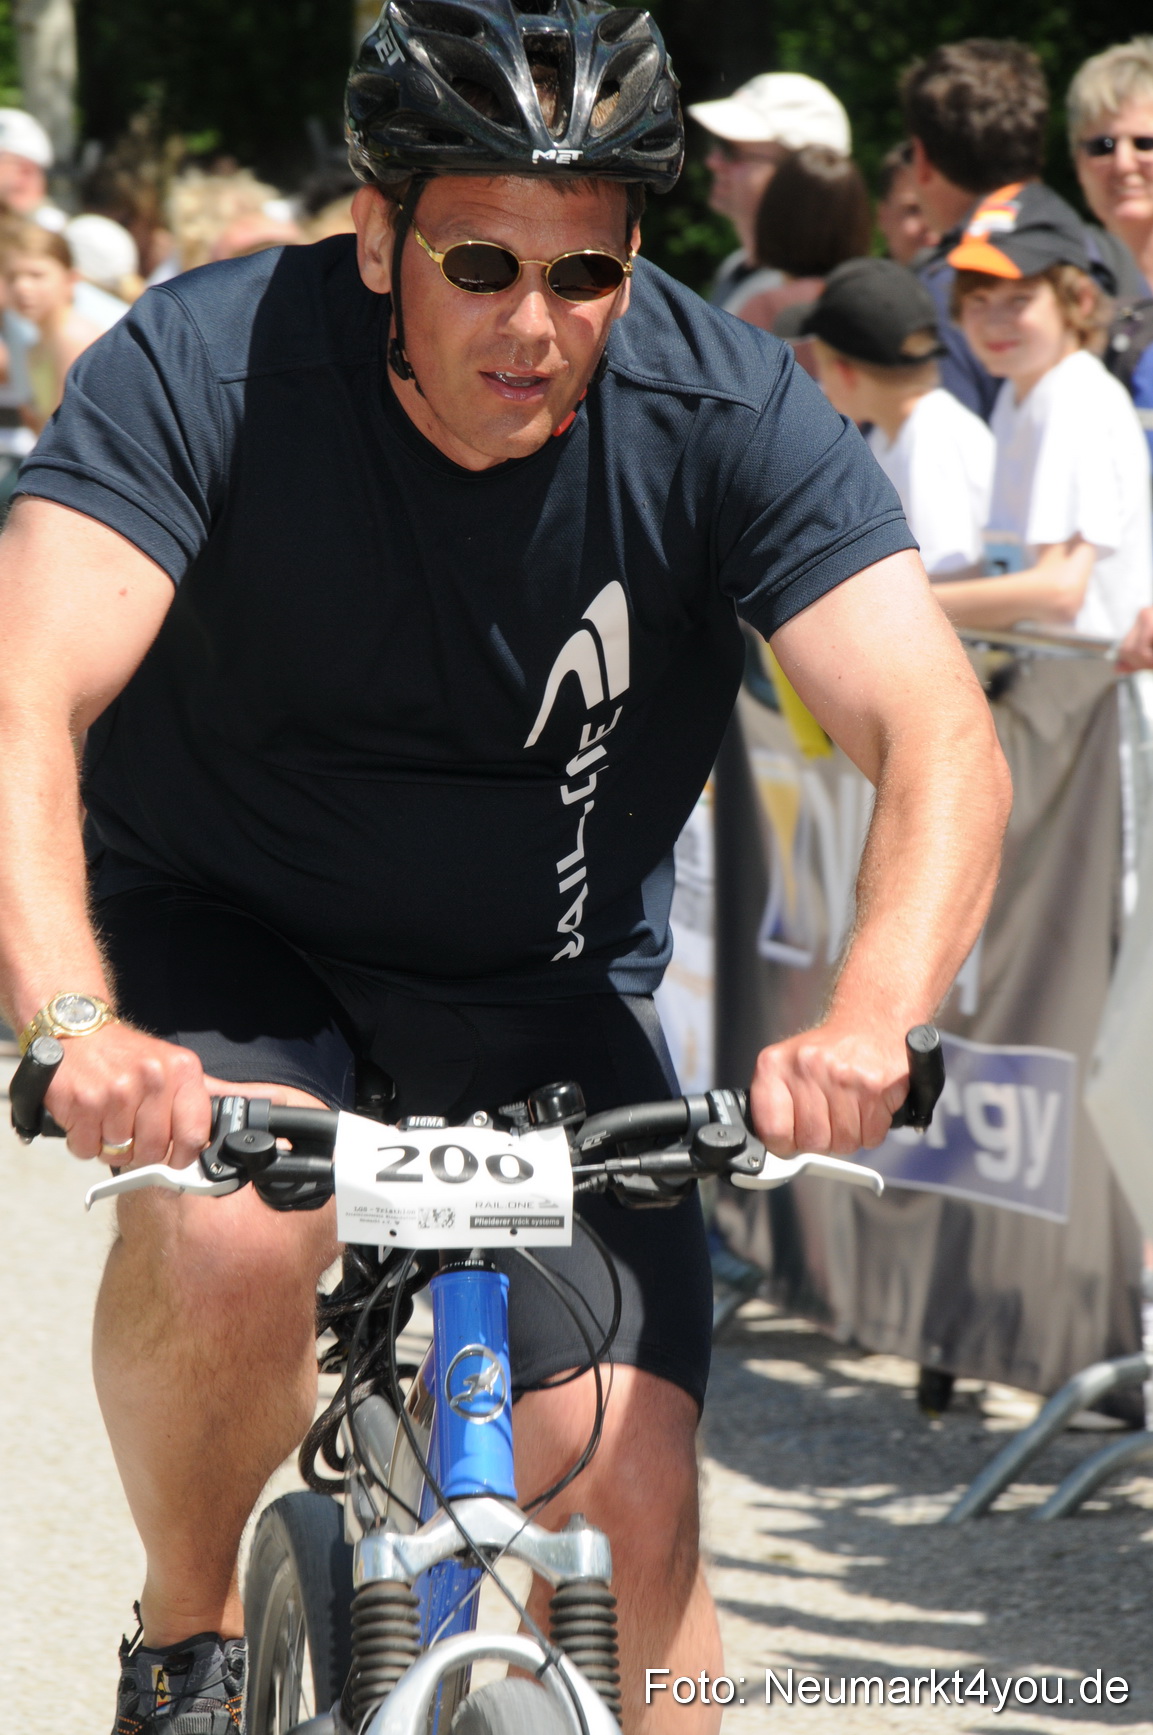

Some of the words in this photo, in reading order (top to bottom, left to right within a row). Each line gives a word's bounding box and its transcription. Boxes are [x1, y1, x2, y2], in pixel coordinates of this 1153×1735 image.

[531, 149, 584, 165] MET
[408, 1115, 445, 1128] SIGMA
[531, 1218, 560, 1227] systems
